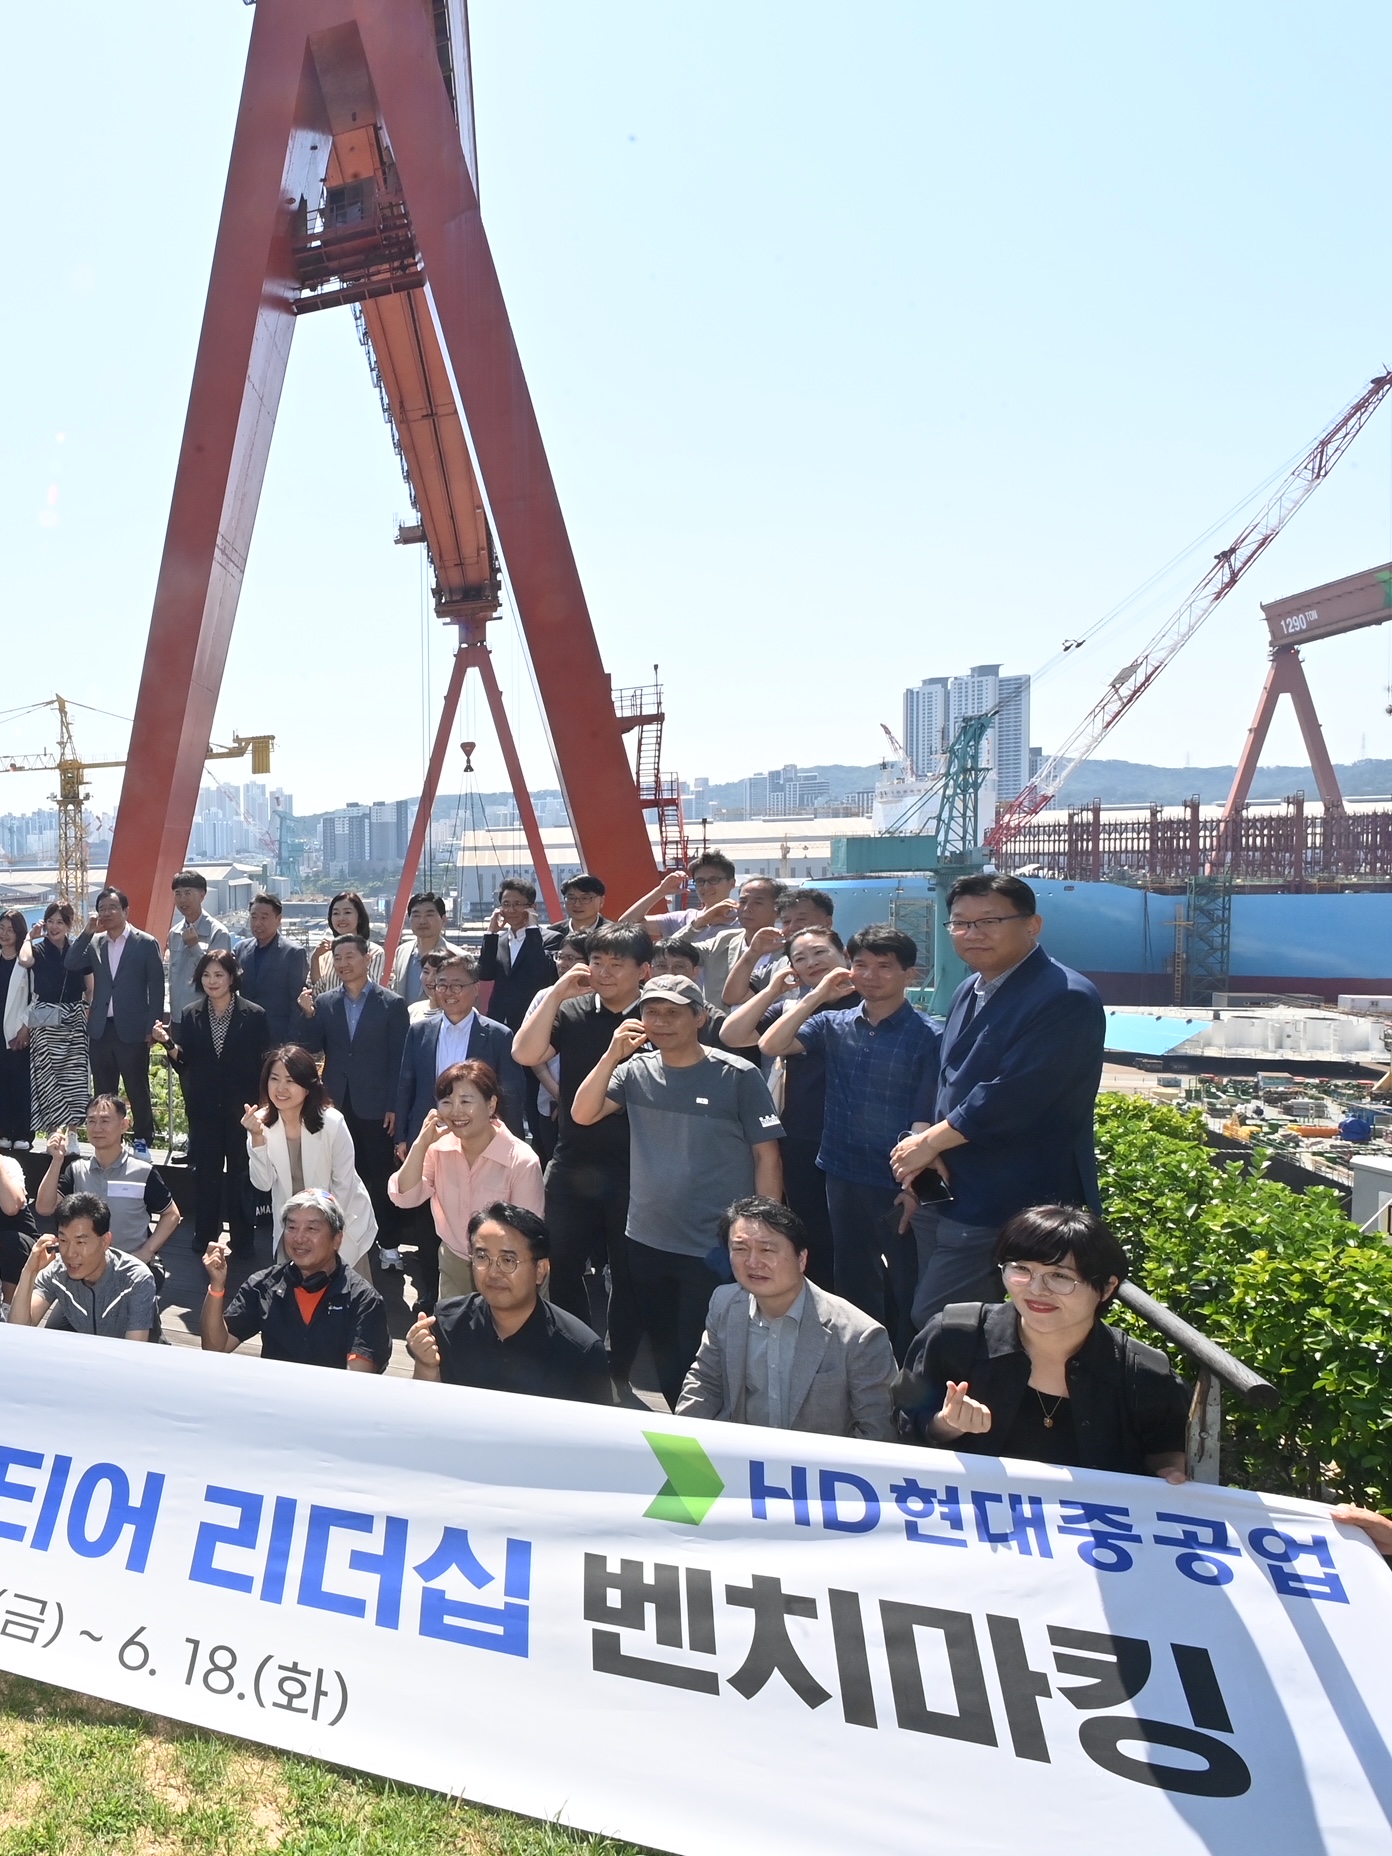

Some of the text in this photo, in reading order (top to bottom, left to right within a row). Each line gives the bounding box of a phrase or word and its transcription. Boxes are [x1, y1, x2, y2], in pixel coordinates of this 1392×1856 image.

[1280, 609, 1319, 635] 1290 TON
[255, 1204, 273, 1216] AMA
[748, 1459, 1351, 1605] HD현대중공업
[118, 1625, 158, 1677] 6.
[184, 1637, 349, 1727] 18.(화)
[188, 1484, 532, 1659] 리더십
[583, 1552, 1252, 1798] 벤치마킹
